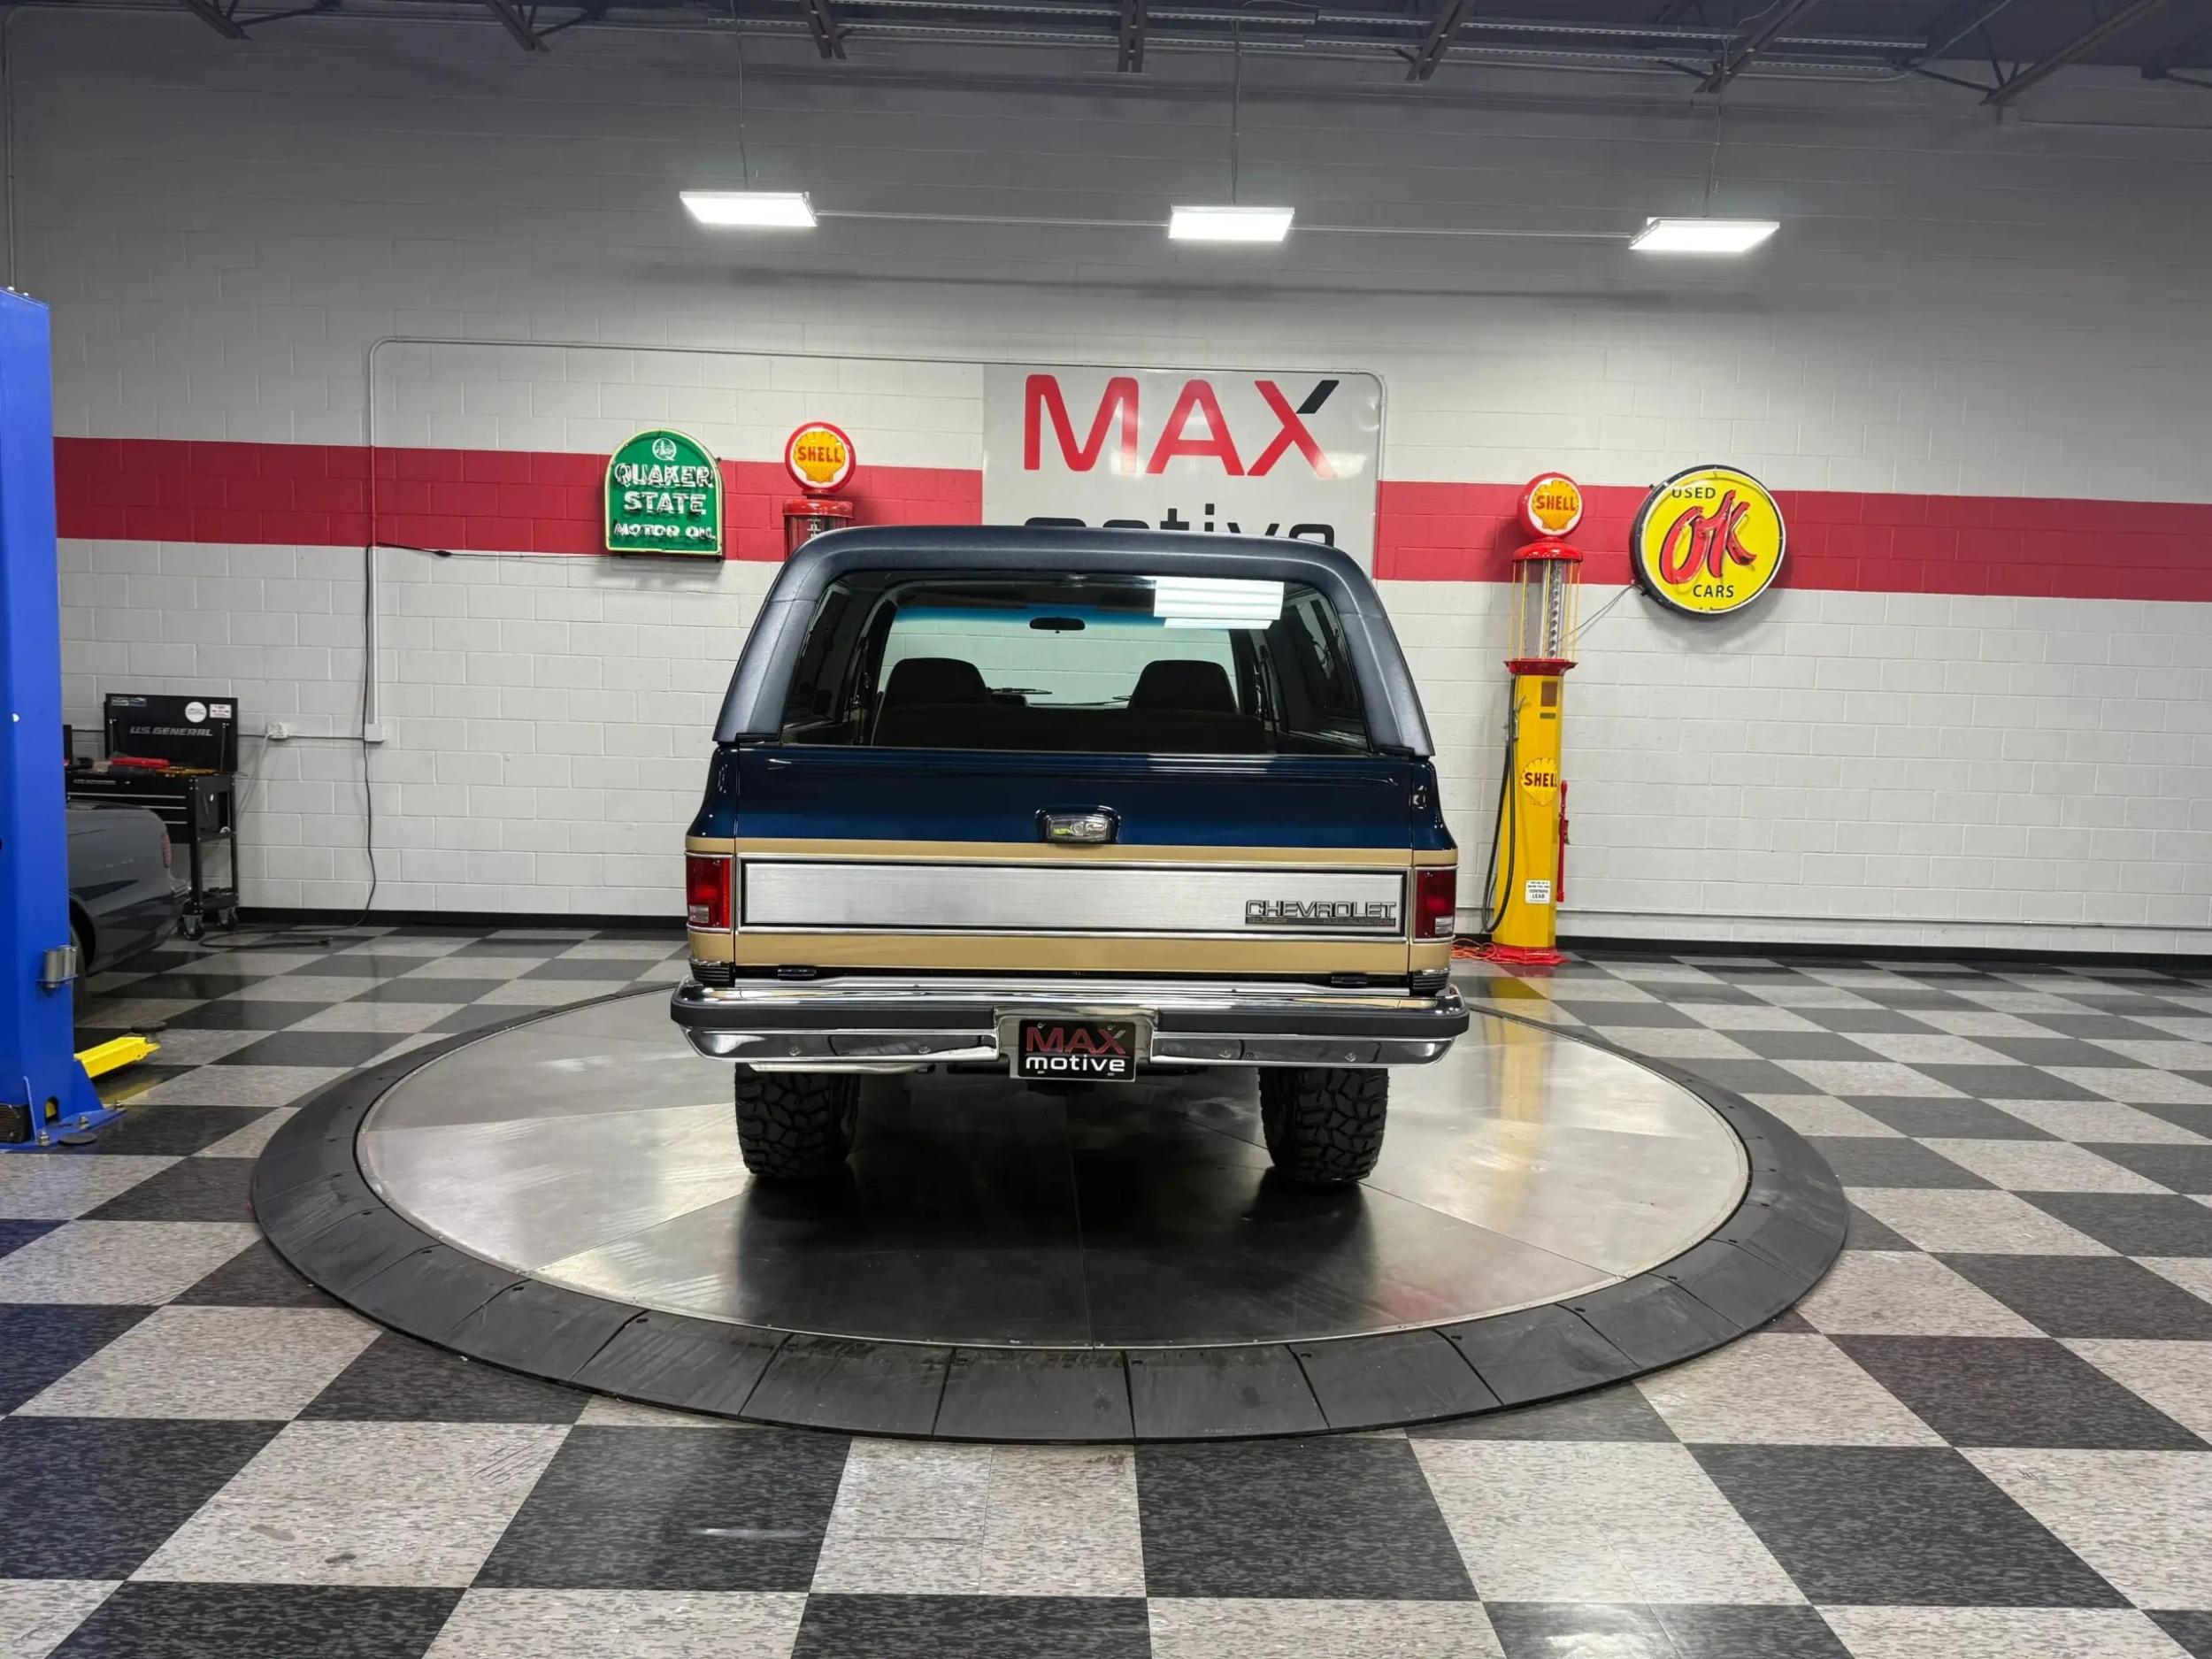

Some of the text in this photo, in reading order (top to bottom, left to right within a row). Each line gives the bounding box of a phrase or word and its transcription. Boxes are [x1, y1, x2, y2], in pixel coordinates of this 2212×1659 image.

[1024, 373, 1340, 478] MAX
[797, 445, 841, 464] SHELL
[615, 463, 714, 488] QUAKER
[1671, 487, 1717, 499] USED
[624, 491, 707, 515] STATE
[1535, 495, 1576, 511] SHELL
[614, 523, 716, 540] MOTOR OIL
[1659, 489, 1757, 585] OK
[1693, 584, 1734, 598] CARS
[152, 726, 213, 737] GENERAL
[1245, 900, 1397, 918] CHEVROLET
[1025, 1026, 1126, 1055] MAX
[1025, 1054, 1125, 1072] motive
